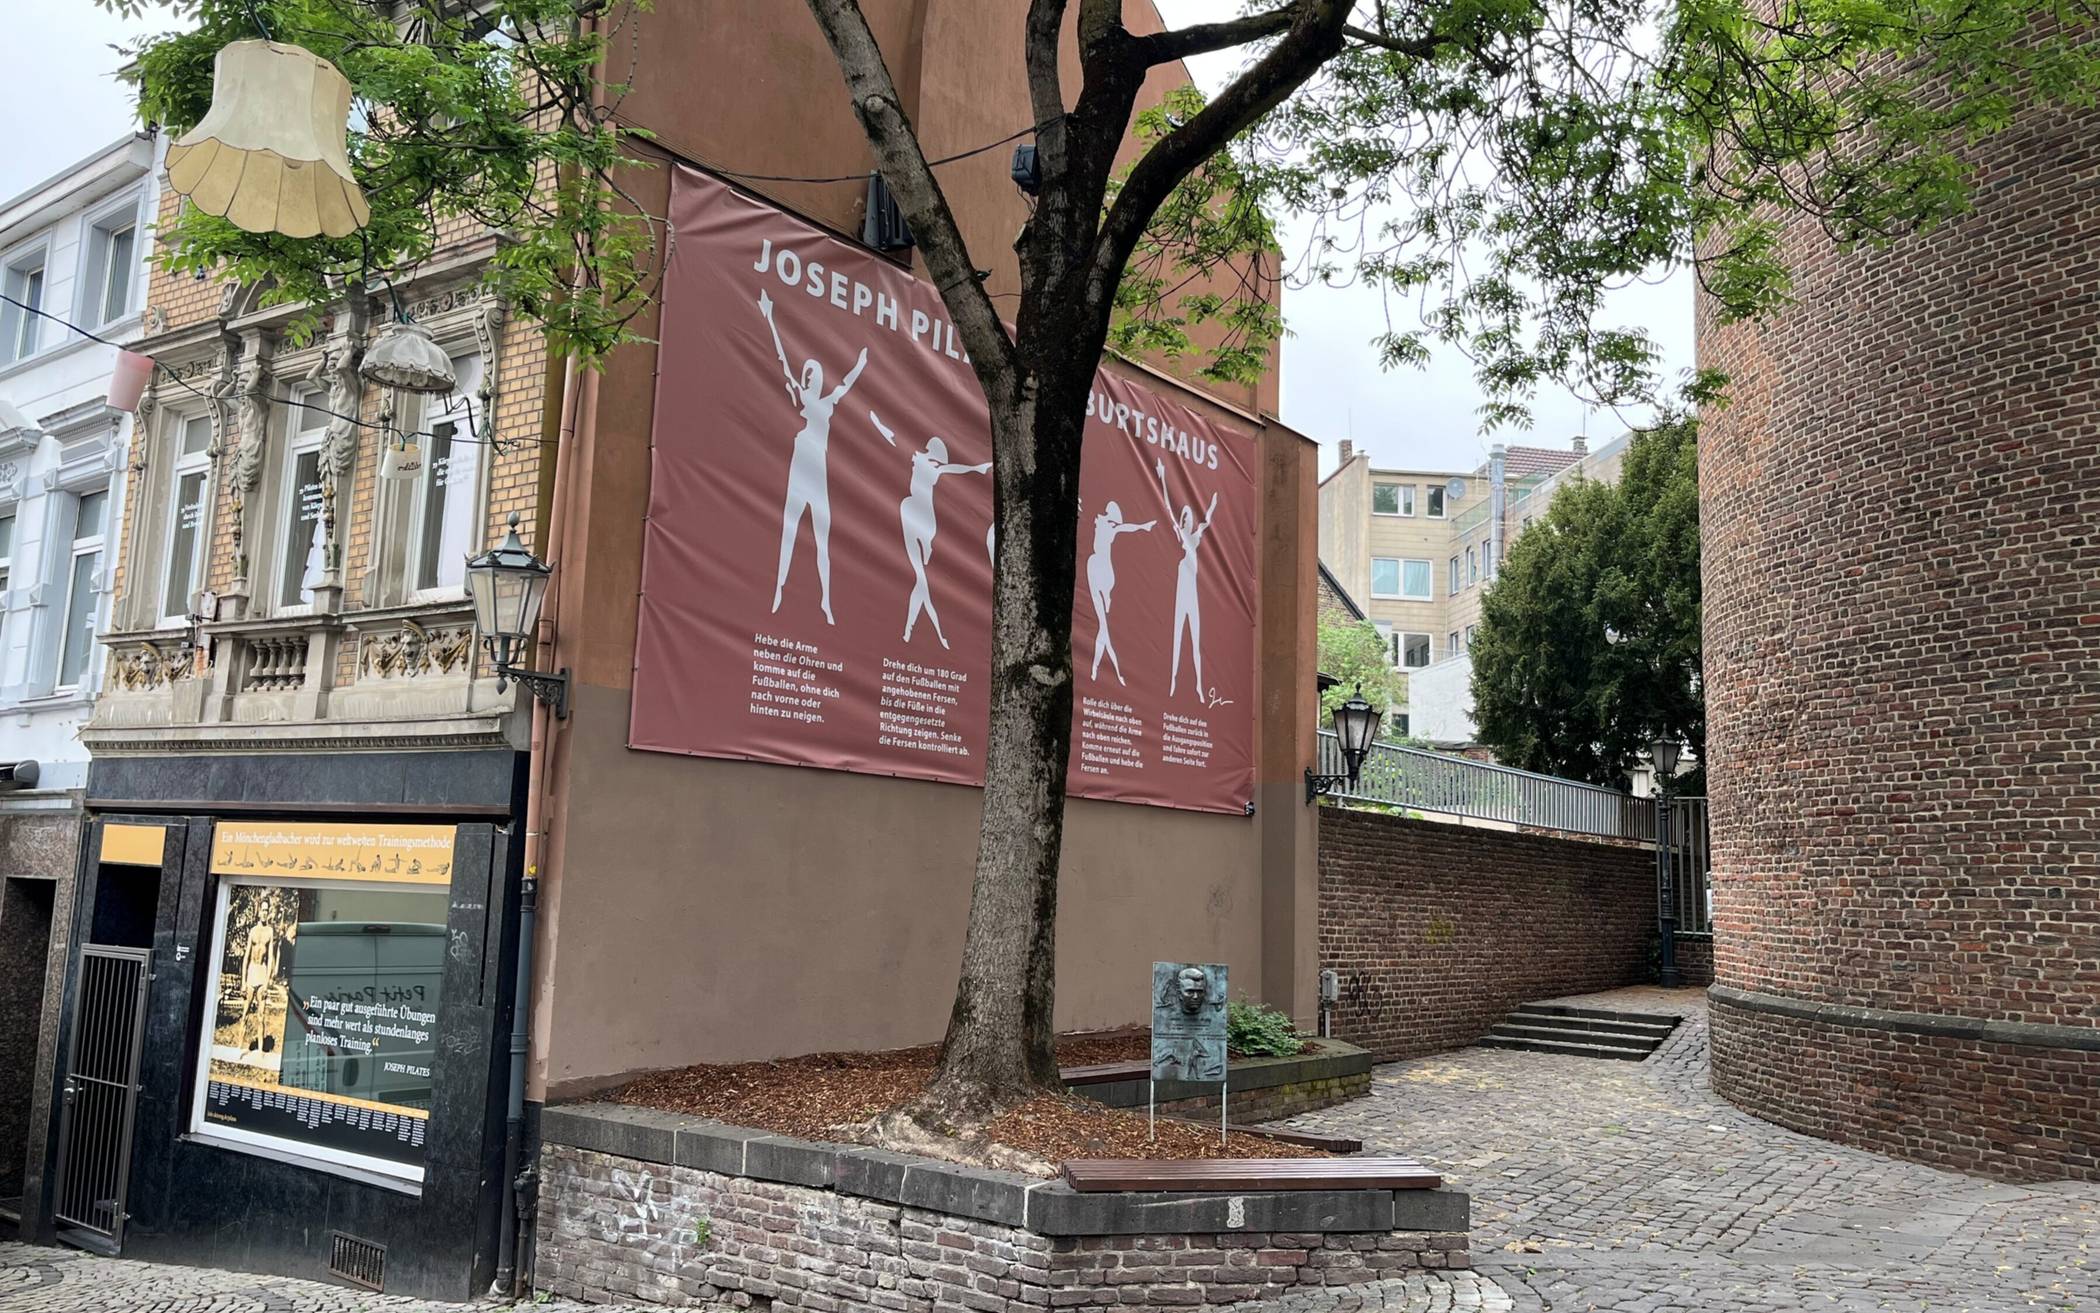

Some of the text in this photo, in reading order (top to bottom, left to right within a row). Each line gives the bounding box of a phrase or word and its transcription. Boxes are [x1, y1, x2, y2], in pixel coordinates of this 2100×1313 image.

[753, 238, 898, 332] JOSEPH
[755, 633, 818, 653] Hebe die Arme
[754, 649, 843, 671] neben die Ohren und
[883, 658, 967, 681] Drehe dich um 180 Grad
[754, 661, 815, 680] komme auf die
[752, 676, 839, 698] Fußballen, ohne dich
[882, 672, 959, 692] auf den Fußballen mit
[751, 691, 821, 708] nach vorne oder
[882, 685, 958, 705] angehobenen Fersen,
[750, 704, 778, 716] hinten
[793, 711, 824, 723] neigen.
[881, 697, 945, 715] bis die Füße in die
[1083, 697, 1132, 713] Rolle dich über die
[880, 711, 945, 727] entgegengesetzte
[1083, 708, 1114, 720] Wirbelsäule
[1129, 717, 1142, 725] oben
[880, 722, 961, 742] Richtung zeigen. Senke
[1094, 722, 1118, 732] während
[1128, 728, 1142, 736] Arme
[879, 736, 969, 756] die Fersen kontrolliert ab.
[1097, 733, 1110, 741] oben
[1111, 737, 1132, 745] reichen.
[1082, 742, 1102, 751] Komme
[1132, 749, 1140, 757] die
[1081, 763, 1099, 773] Fersen
[1121, 759, 1134, 767] hebe
[1135, 760, 1143, 768] die
[323, 1001, 339, 1012] paar
[341, 1001, 353, 1015] gut
[355, 1003, 398, 1018] ausgeführte
[400, 1005, 435, 1025] Übungen
[305, 1030, 337, 1045] planloses
[308, 1014, 323, 1026] sind
[324, 1016, 343, 1029] mehr
[345, 1020, 361, 1032] wert
[363, 1020, 373, 1033] als
[375, 1023, 429, 1044] stundenlanges
[384, 1062, 430, 1077] JOSEPH PILATES
